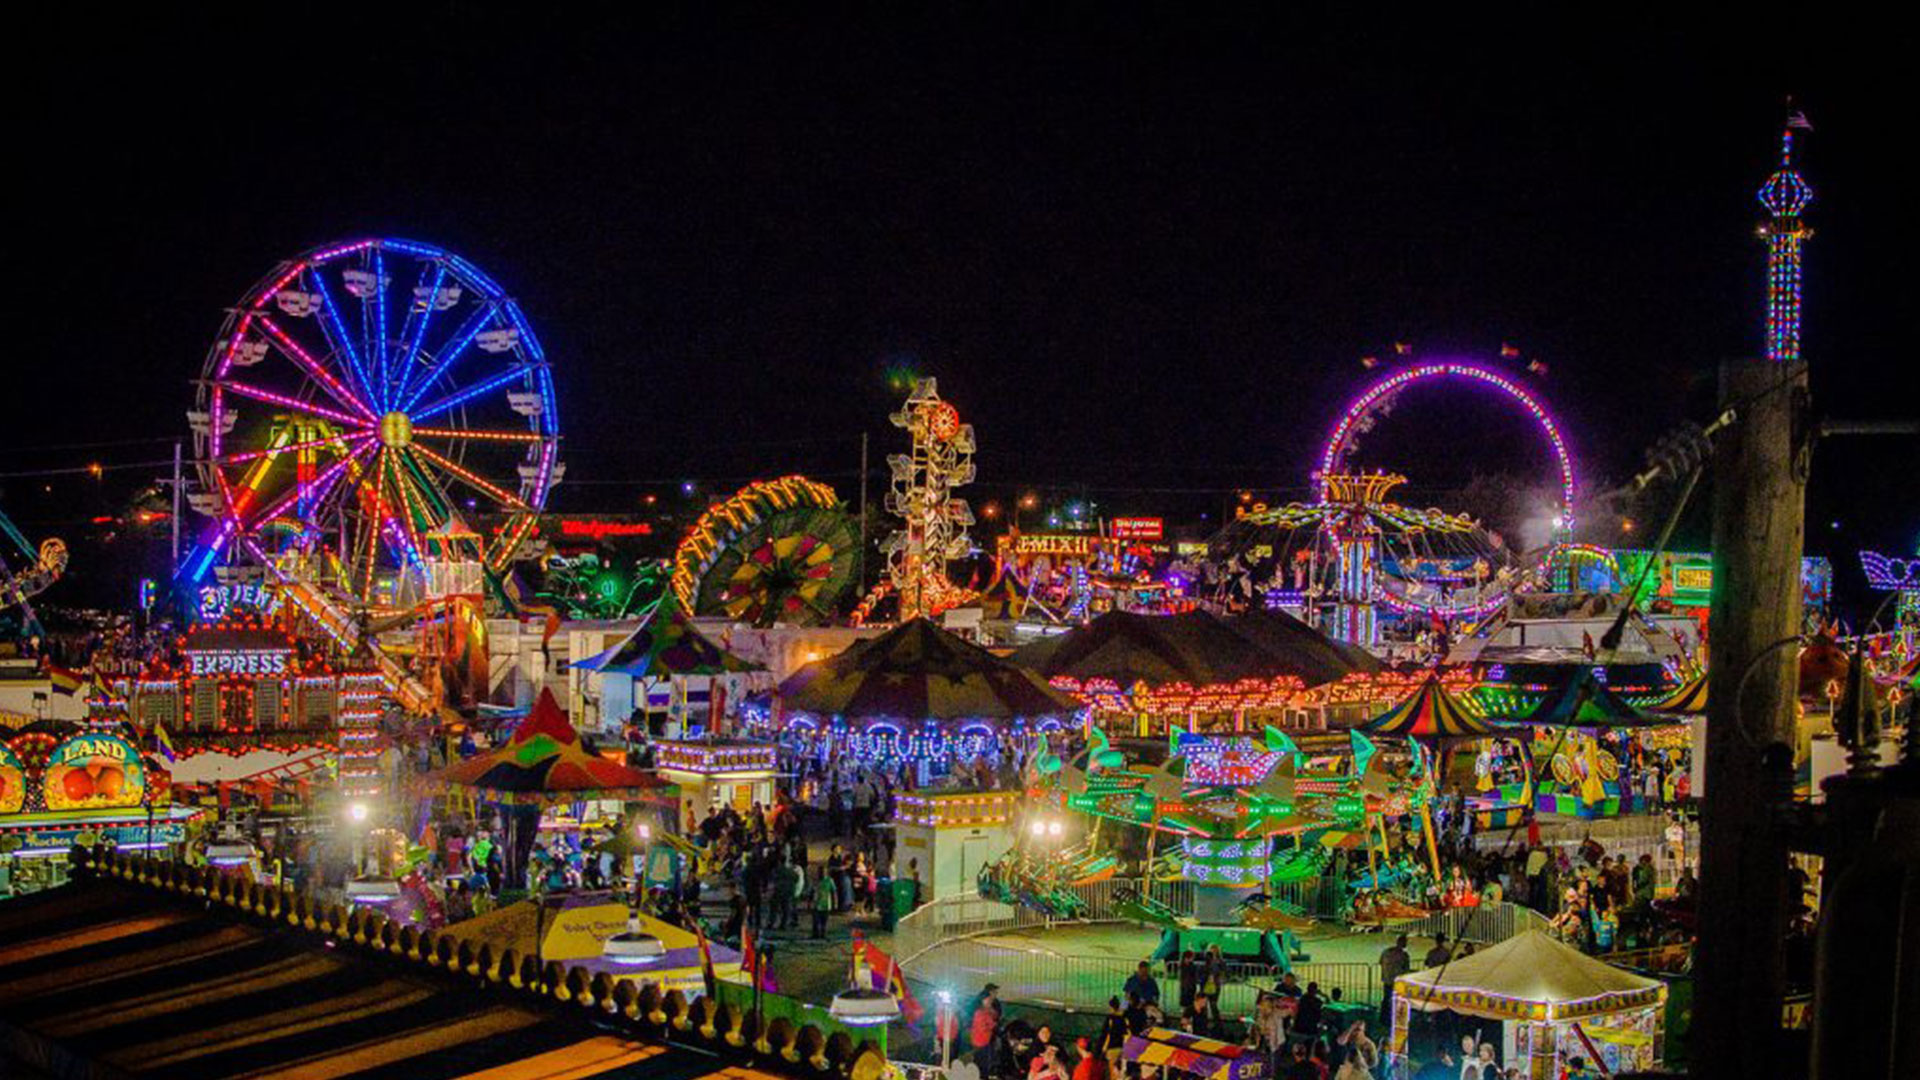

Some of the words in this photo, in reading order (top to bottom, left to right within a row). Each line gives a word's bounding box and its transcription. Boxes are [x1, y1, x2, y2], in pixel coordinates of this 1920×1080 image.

[192, 655, 284, 673] EXPRESS
[63, 740, 125, 762] LAND
[713, 753, 772, 767] TICKETS
